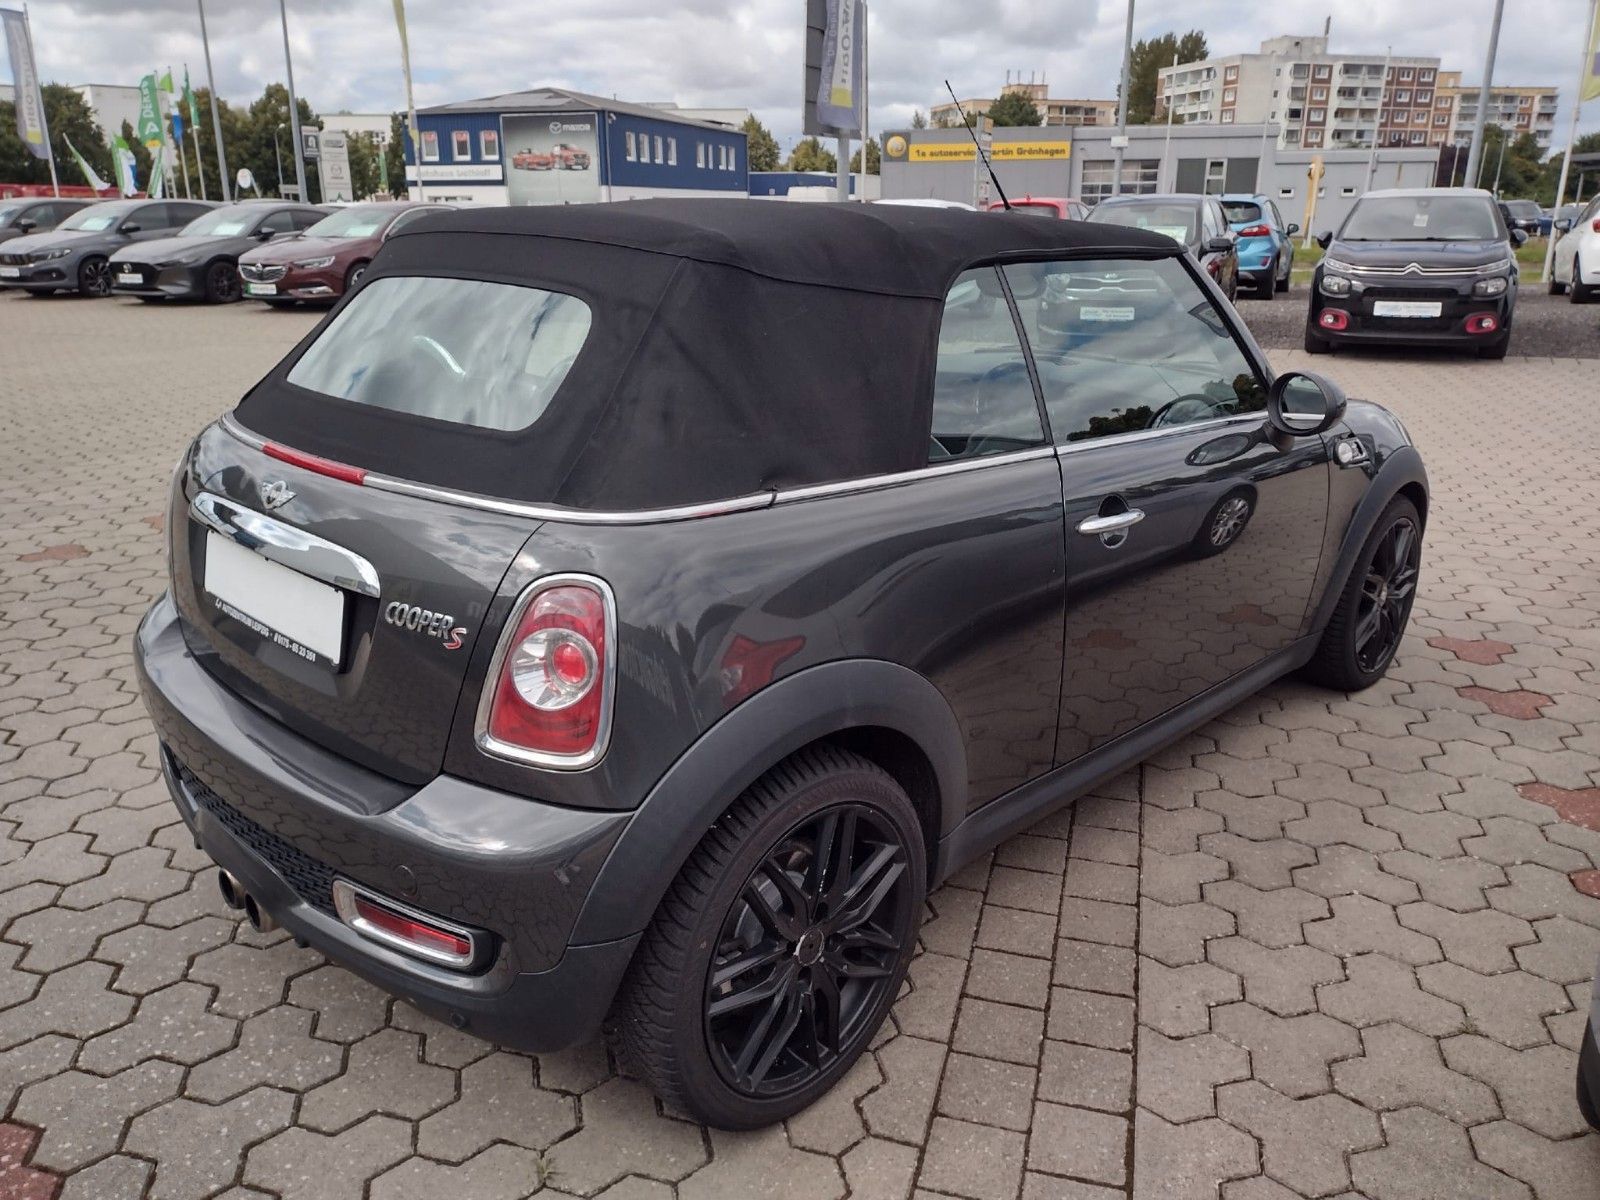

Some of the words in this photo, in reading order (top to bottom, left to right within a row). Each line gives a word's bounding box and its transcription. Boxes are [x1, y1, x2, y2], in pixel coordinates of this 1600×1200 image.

[929, 148, 976, 157] autoservic
[385, 601, 454, 640] COOPER
[442, 627, 467, 650] S
